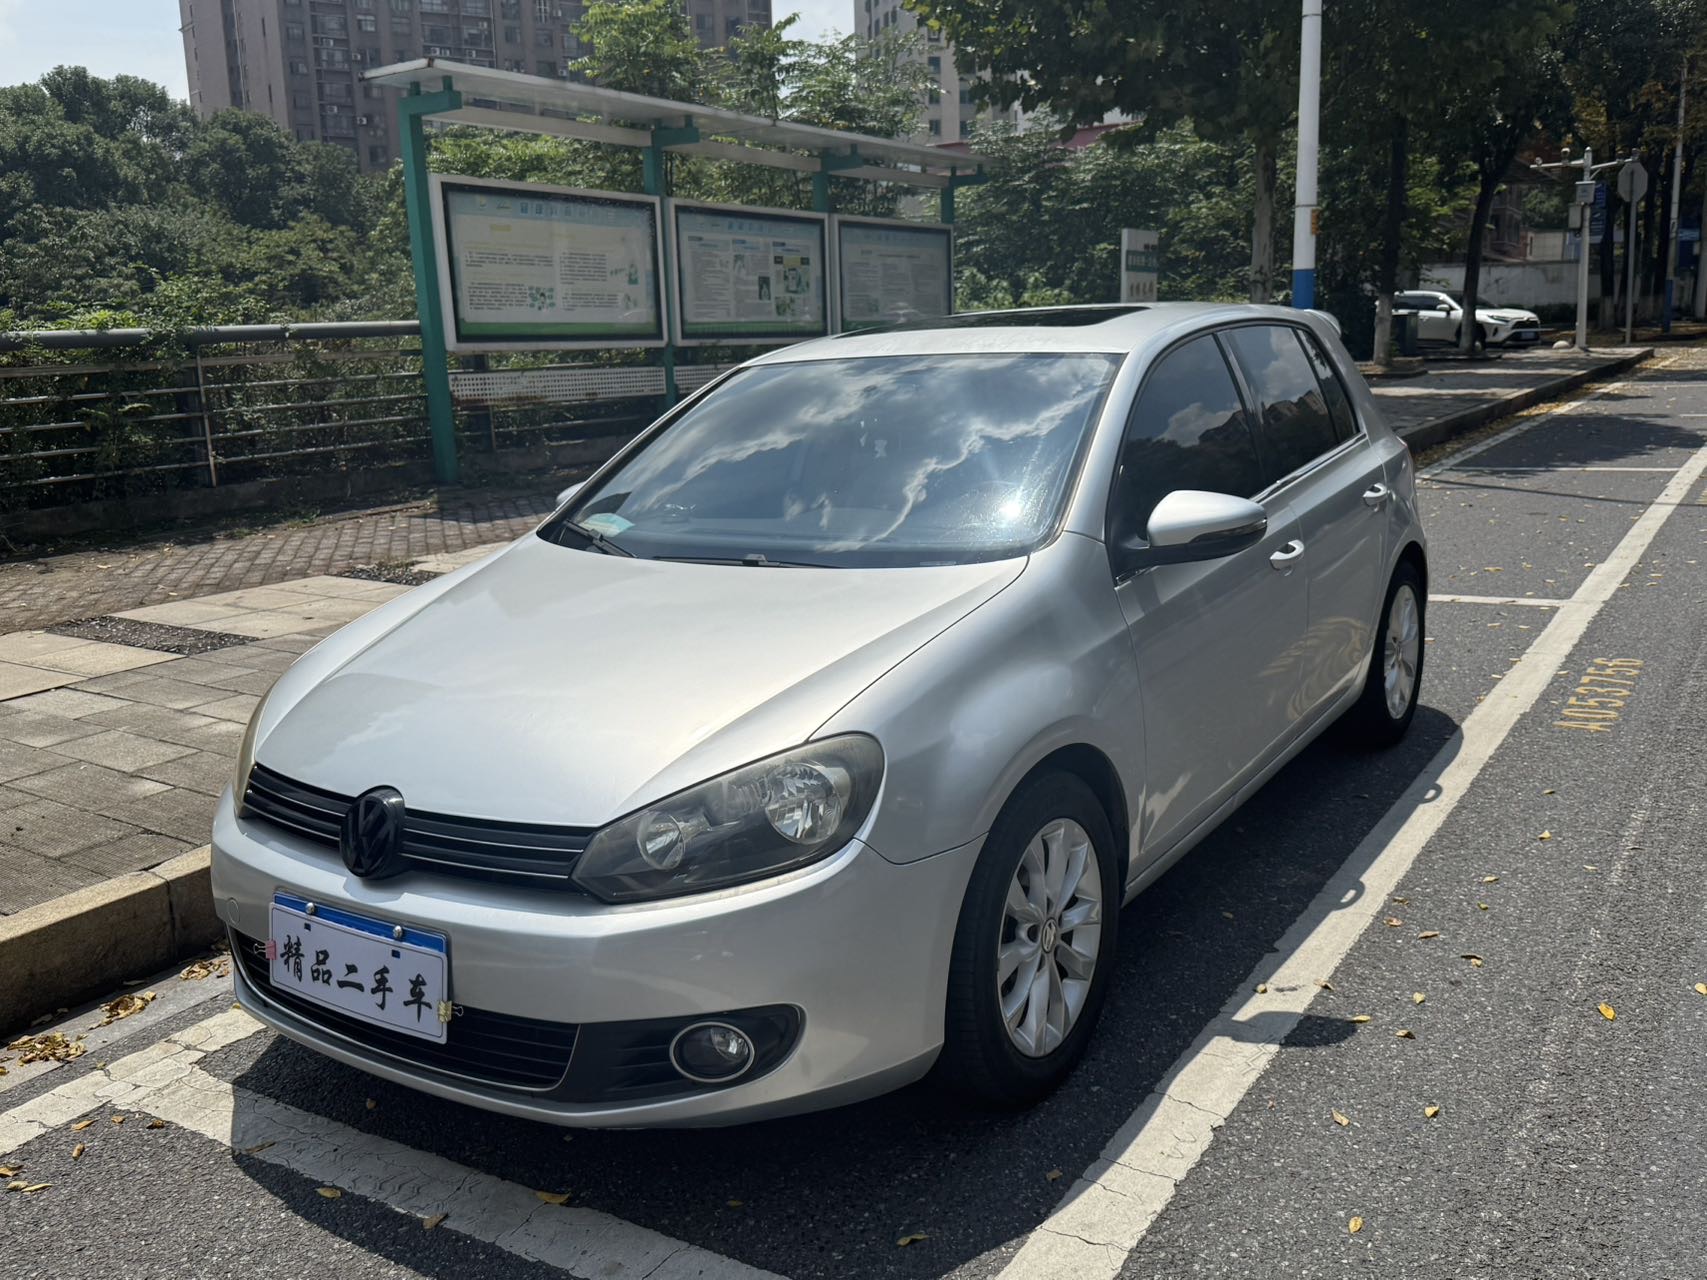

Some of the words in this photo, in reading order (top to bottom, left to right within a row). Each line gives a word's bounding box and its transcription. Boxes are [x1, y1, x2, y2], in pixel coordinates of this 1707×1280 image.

[1553, 657, 1644, 732] A053756
[280, 934, 432, 1022] 精品二手车
